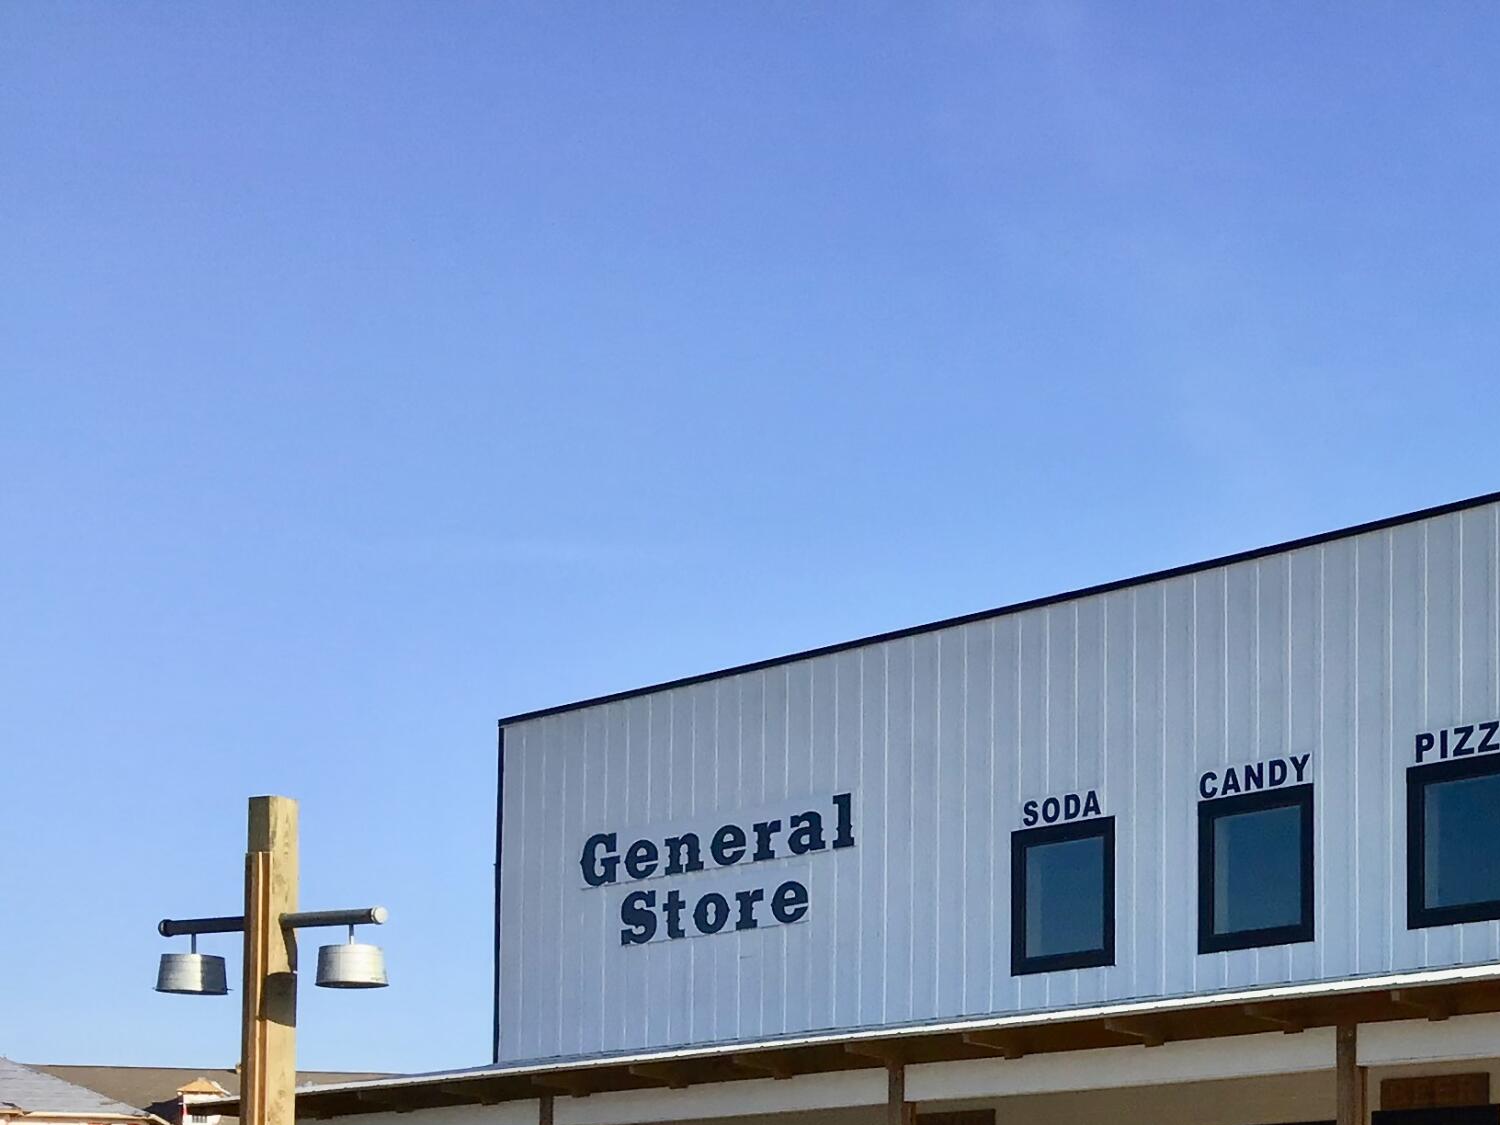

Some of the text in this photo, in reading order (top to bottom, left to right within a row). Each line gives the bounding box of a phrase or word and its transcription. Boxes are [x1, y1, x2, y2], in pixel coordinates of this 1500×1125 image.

[1199, 754, 1310, 799] CANDY
[1022, 790, 1101, 827] SODA
[580, 792, 855, 887] General
[620, 880, 809, 946] Store
